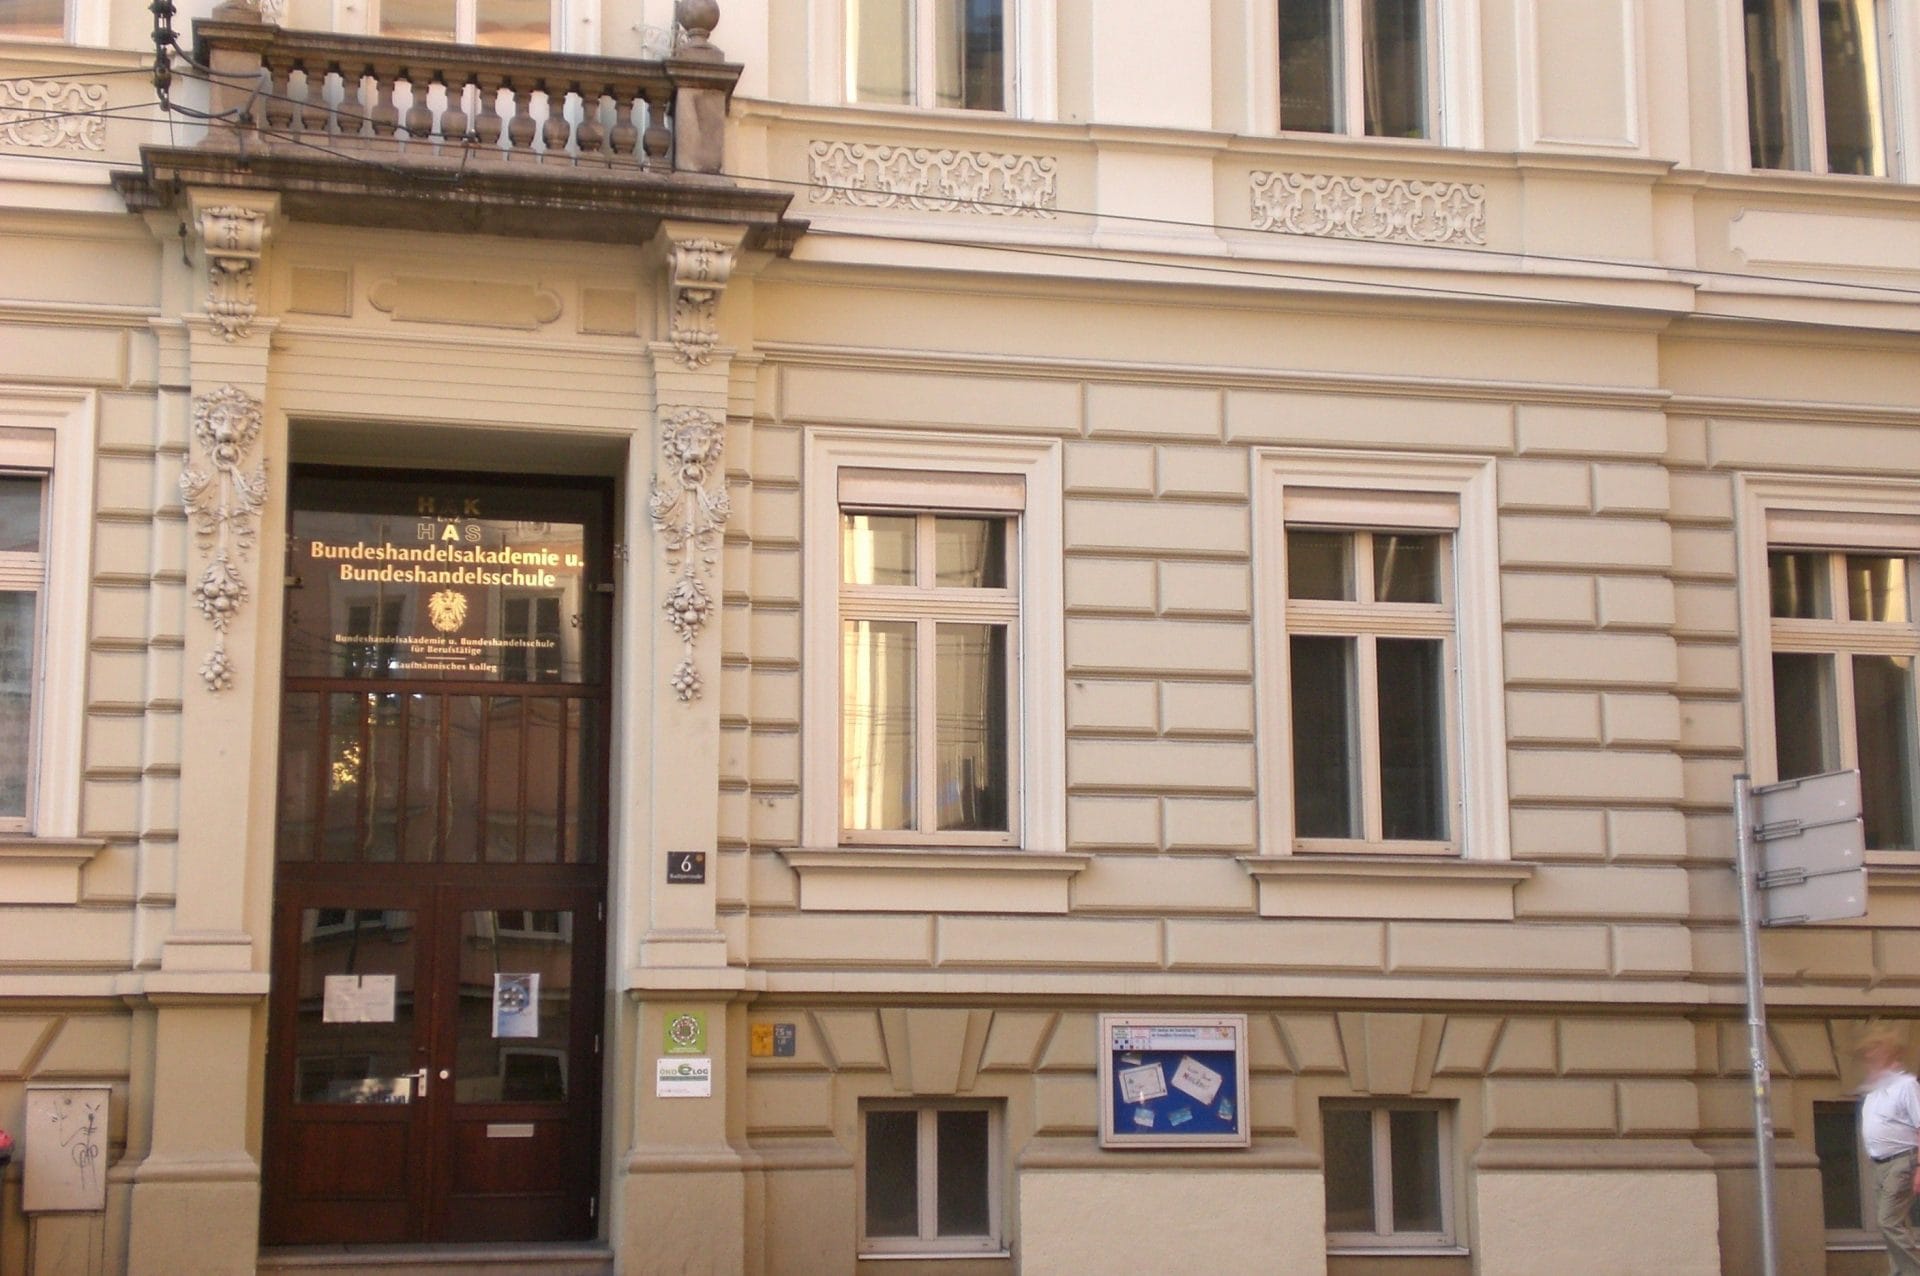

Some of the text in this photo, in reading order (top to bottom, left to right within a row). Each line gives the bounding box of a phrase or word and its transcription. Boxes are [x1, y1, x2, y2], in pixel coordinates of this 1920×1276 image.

[417, 523, 481, 541] HAS
[311, 541, 584, 567] Bundeshandelsakademie u.
[340, 565, 556, 586] Bundeshandelsschule
[335, 634, 445, 645] Bundeshandelsakademie
[460, 637, 555, 648] Bundeshandelsschule
[427, 646, 482, 655] Berufstätige
[468, 663, 497, 672] Kolleg
[681, 854, 691, 872] 6
